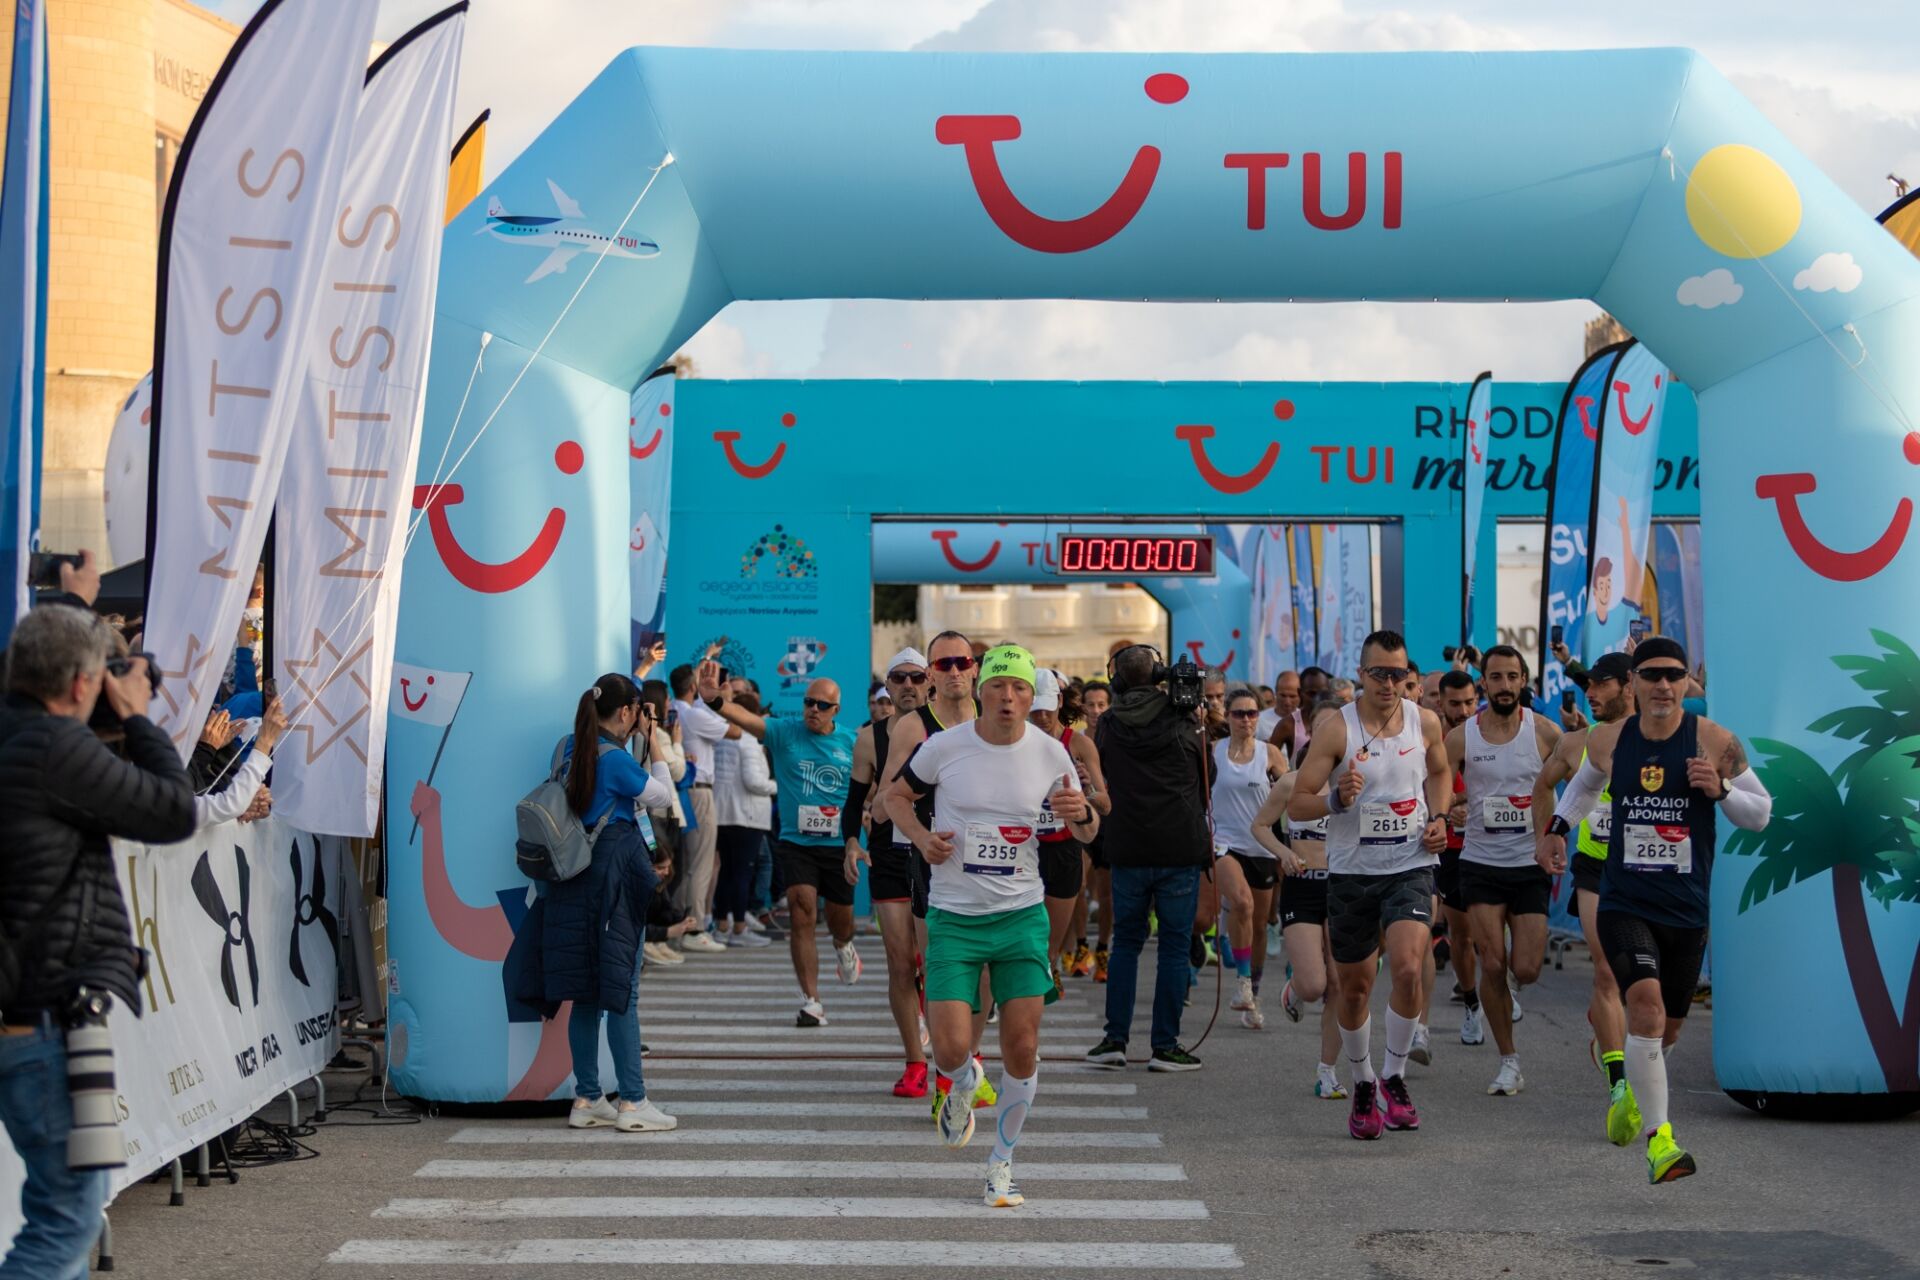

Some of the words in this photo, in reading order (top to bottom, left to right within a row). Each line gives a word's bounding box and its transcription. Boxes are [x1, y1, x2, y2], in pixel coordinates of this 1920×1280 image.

[1224, 152, 1403, 231] TUI
[618, 236, 638, 249] TUI
[319, 203, 402, 580] MITSIS
[1415, 405, 1553, 439] RHOD
[1310, 445, 1394, 484] TUI
[1063, 539, 1197, 571] 00:00:00
[806, 817, 832, 828] 2678
[1039, 813, 1054, 823] 03
[1494, 811, 1526, 822] 2001
[1627, 810, 1684, 821] ΔΡΟΜΕΙΣ
[1372, 818, 1408, 832] 2615
[977, 844, 1017, 860] 2359
[1637, 844, 1678, 858] 2625
